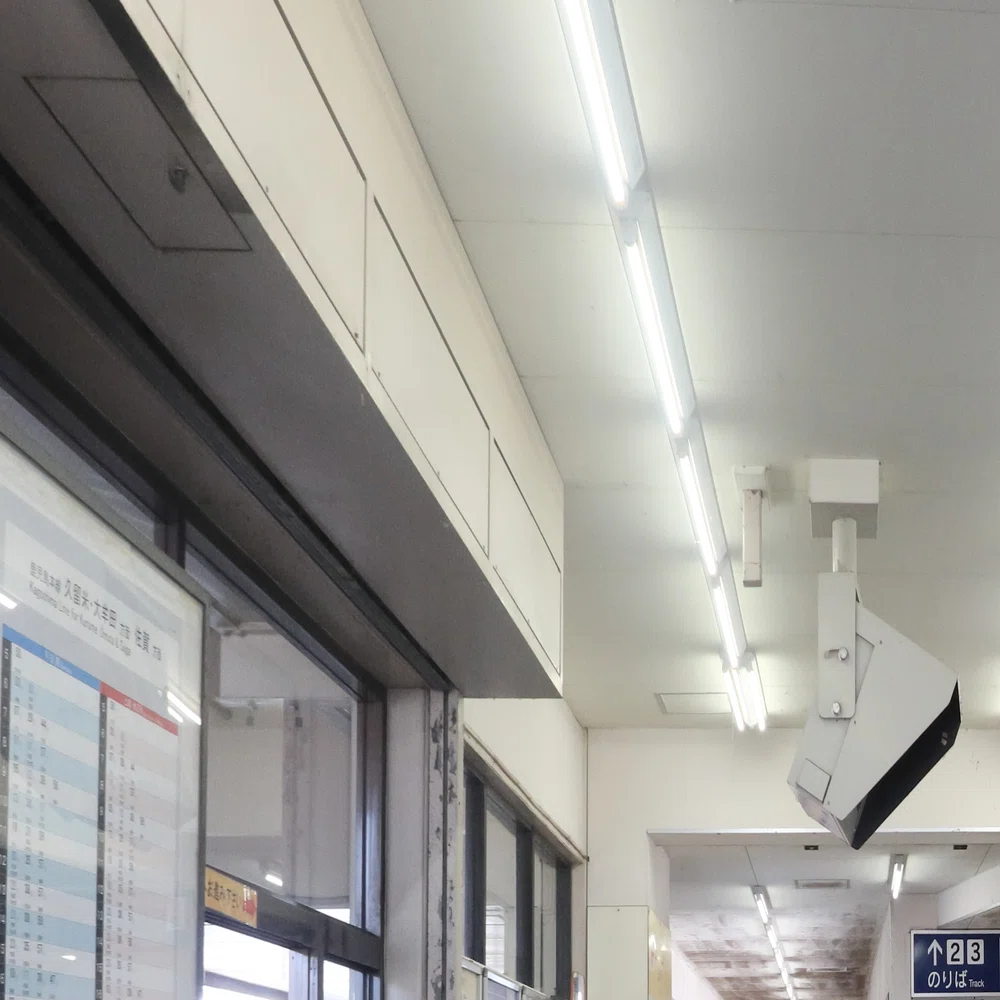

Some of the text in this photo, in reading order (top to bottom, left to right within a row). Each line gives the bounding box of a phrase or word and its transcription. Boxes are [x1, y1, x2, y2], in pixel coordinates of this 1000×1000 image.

[950, 942, 980, 962] 2 3
[927, 969, 985, 989] のりば Track
